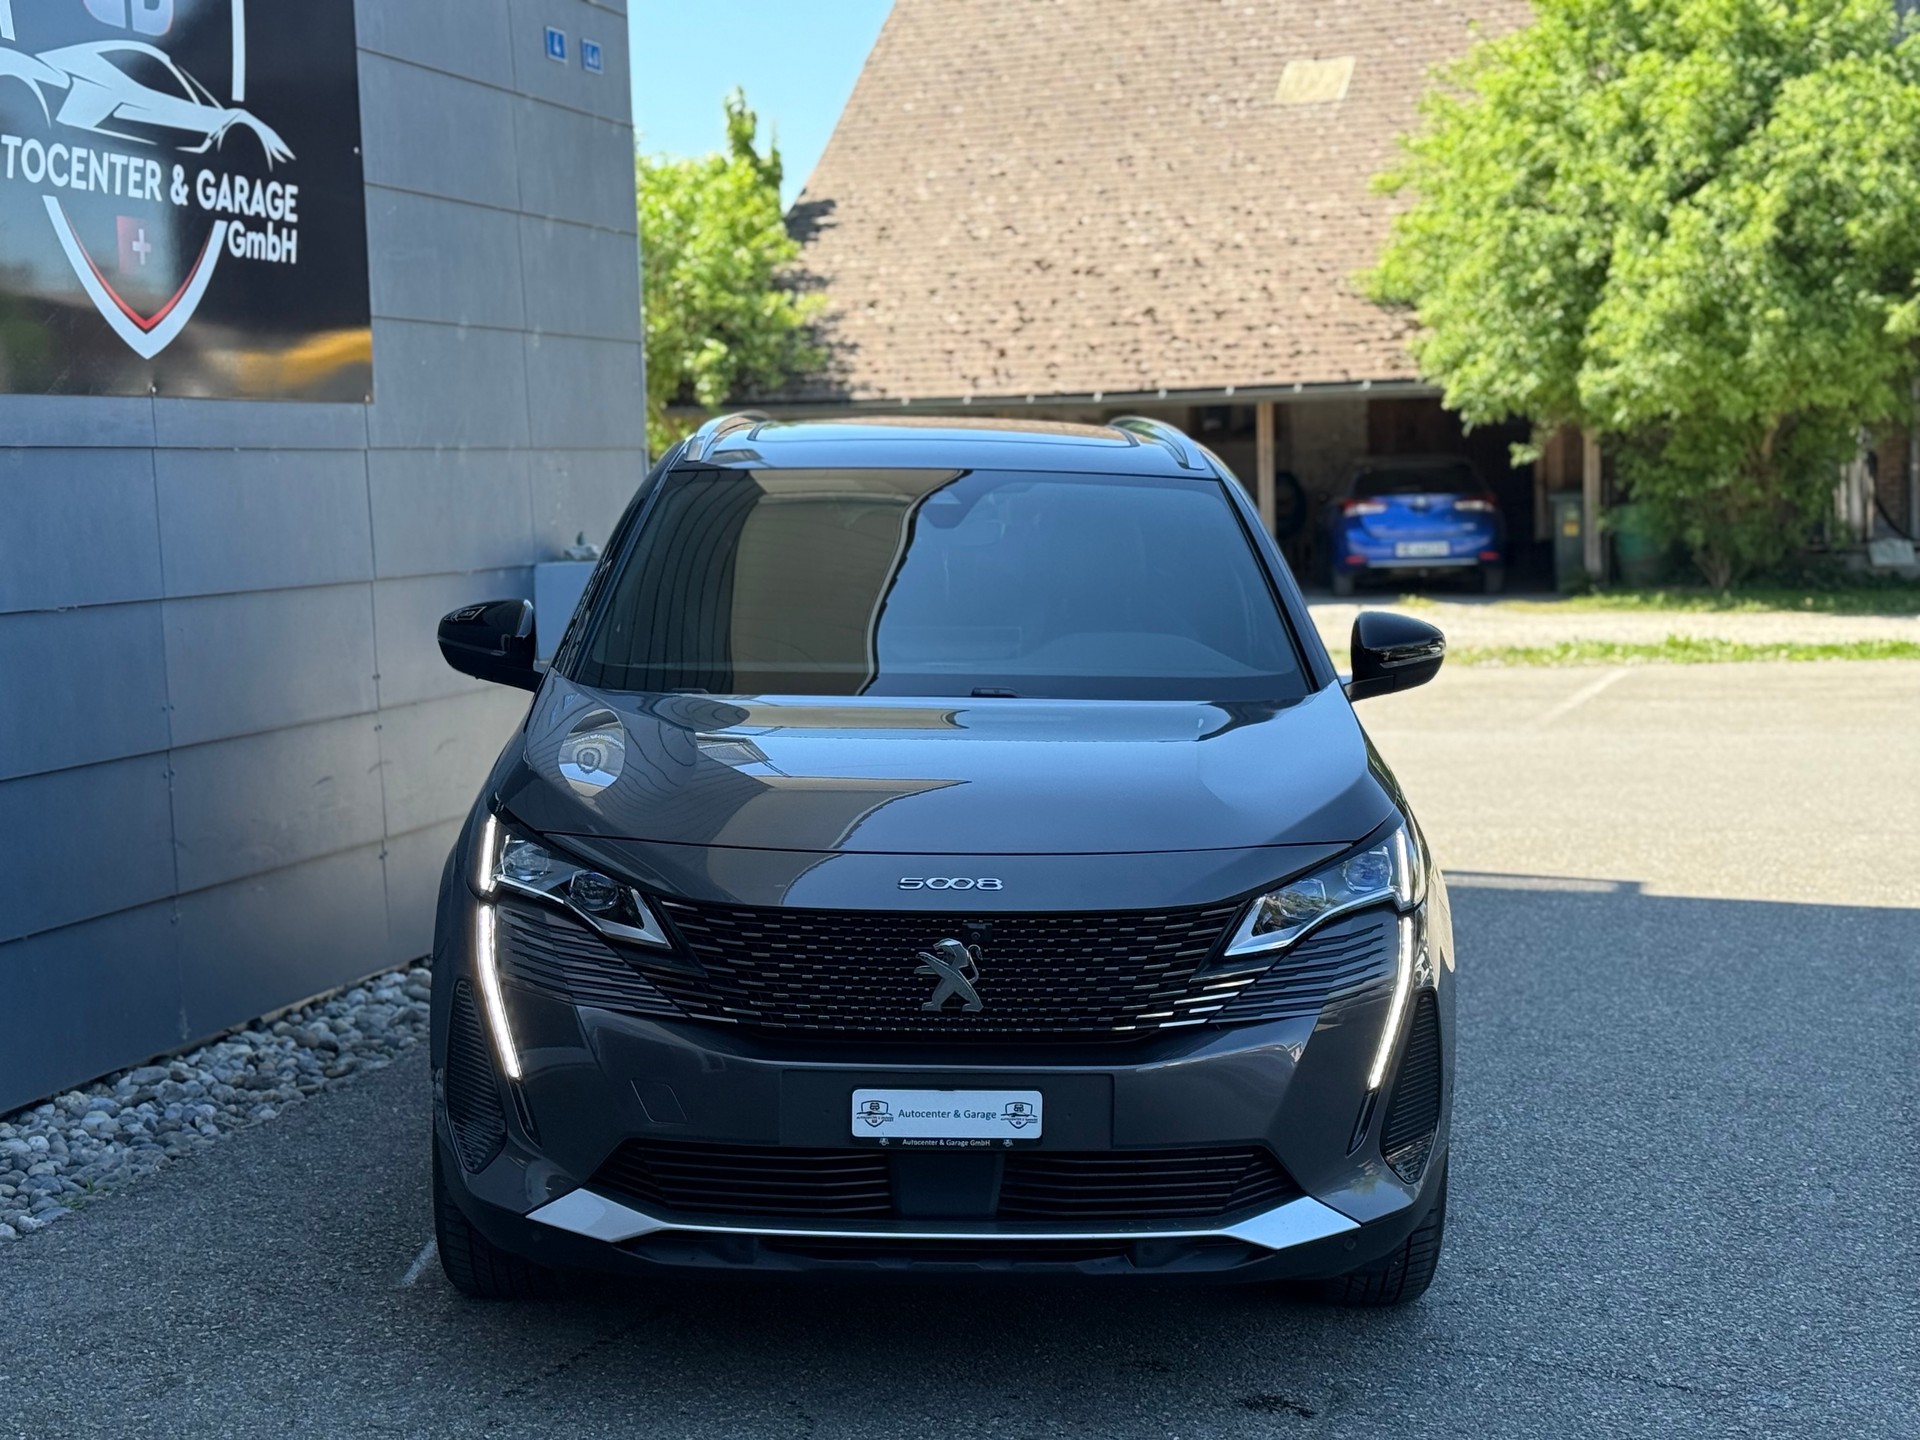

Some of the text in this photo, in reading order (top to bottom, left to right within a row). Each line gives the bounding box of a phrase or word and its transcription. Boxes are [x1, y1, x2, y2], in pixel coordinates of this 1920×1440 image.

[1, 134, 299, 223] TOCENTER & GARAGE
[227, 220, 298, 264] GmbH
[899, 877, 1004, 890] 5008
[898, 1109, 951, 1119] Autocenter
[953, 1109, 961, 1119] &
[963, 1110, 997, 1121] Garage
[902, 1138, 938, 1146] Autocenter
[946, 1139, 969, 1147] Garage
[969, 1139, 991, 1147] GmbH
